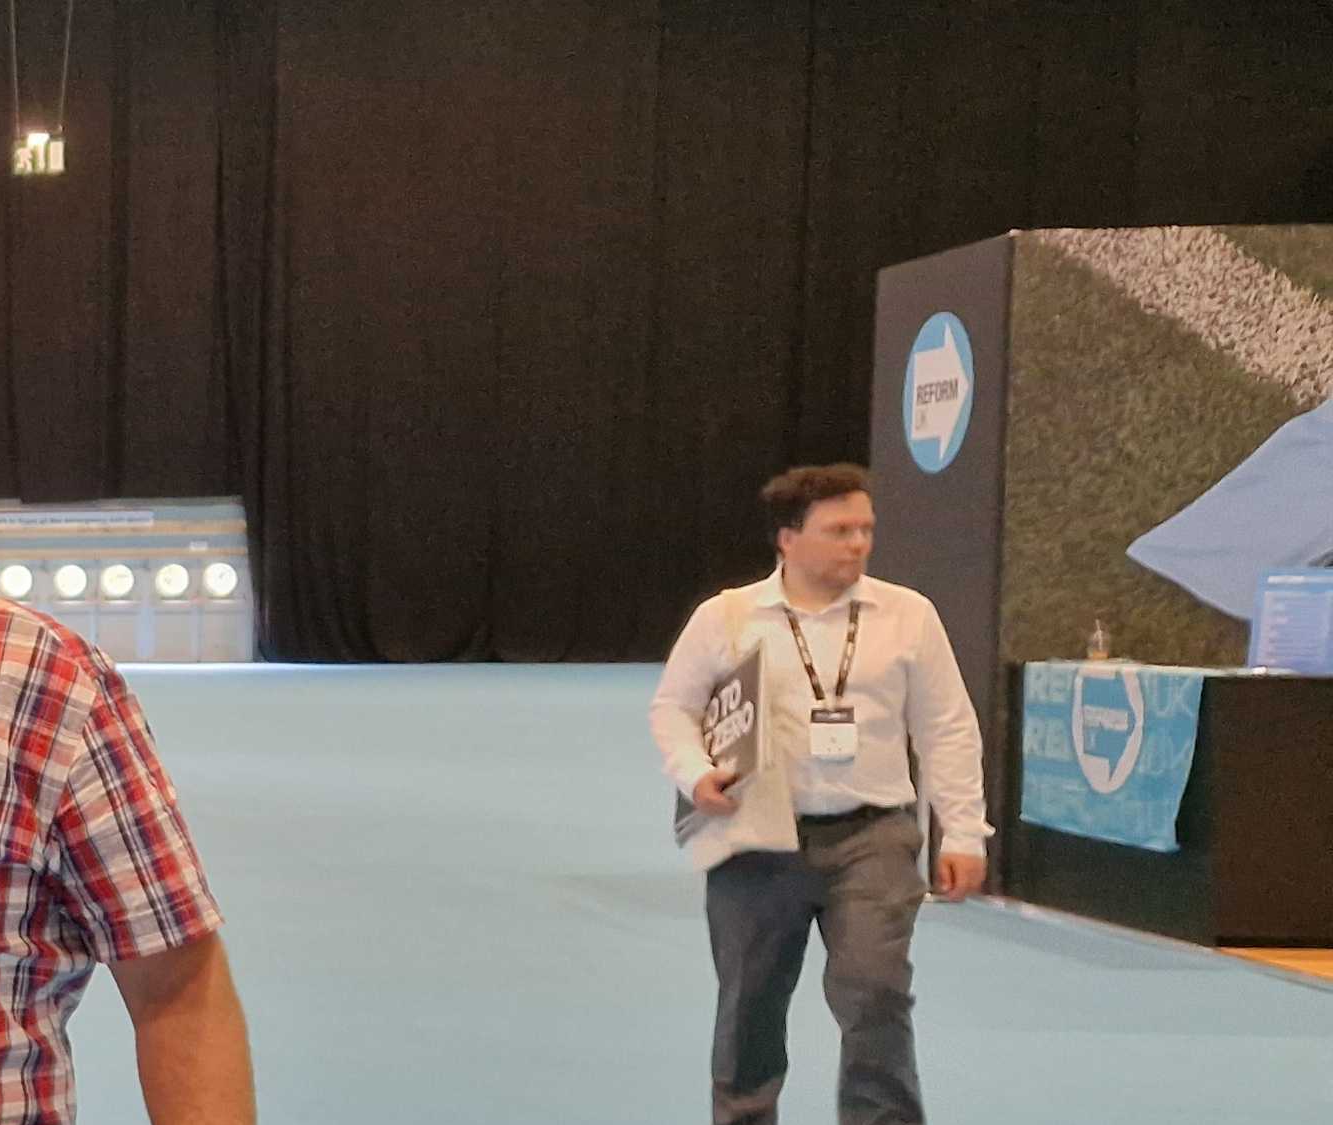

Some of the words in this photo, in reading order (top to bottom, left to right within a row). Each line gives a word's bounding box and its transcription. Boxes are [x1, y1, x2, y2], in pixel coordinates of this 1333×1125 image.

[916, 379, 959, 406] REFORM
[718, 679, 742, 718] TO
[710, 701, 755, 756] ZERO
